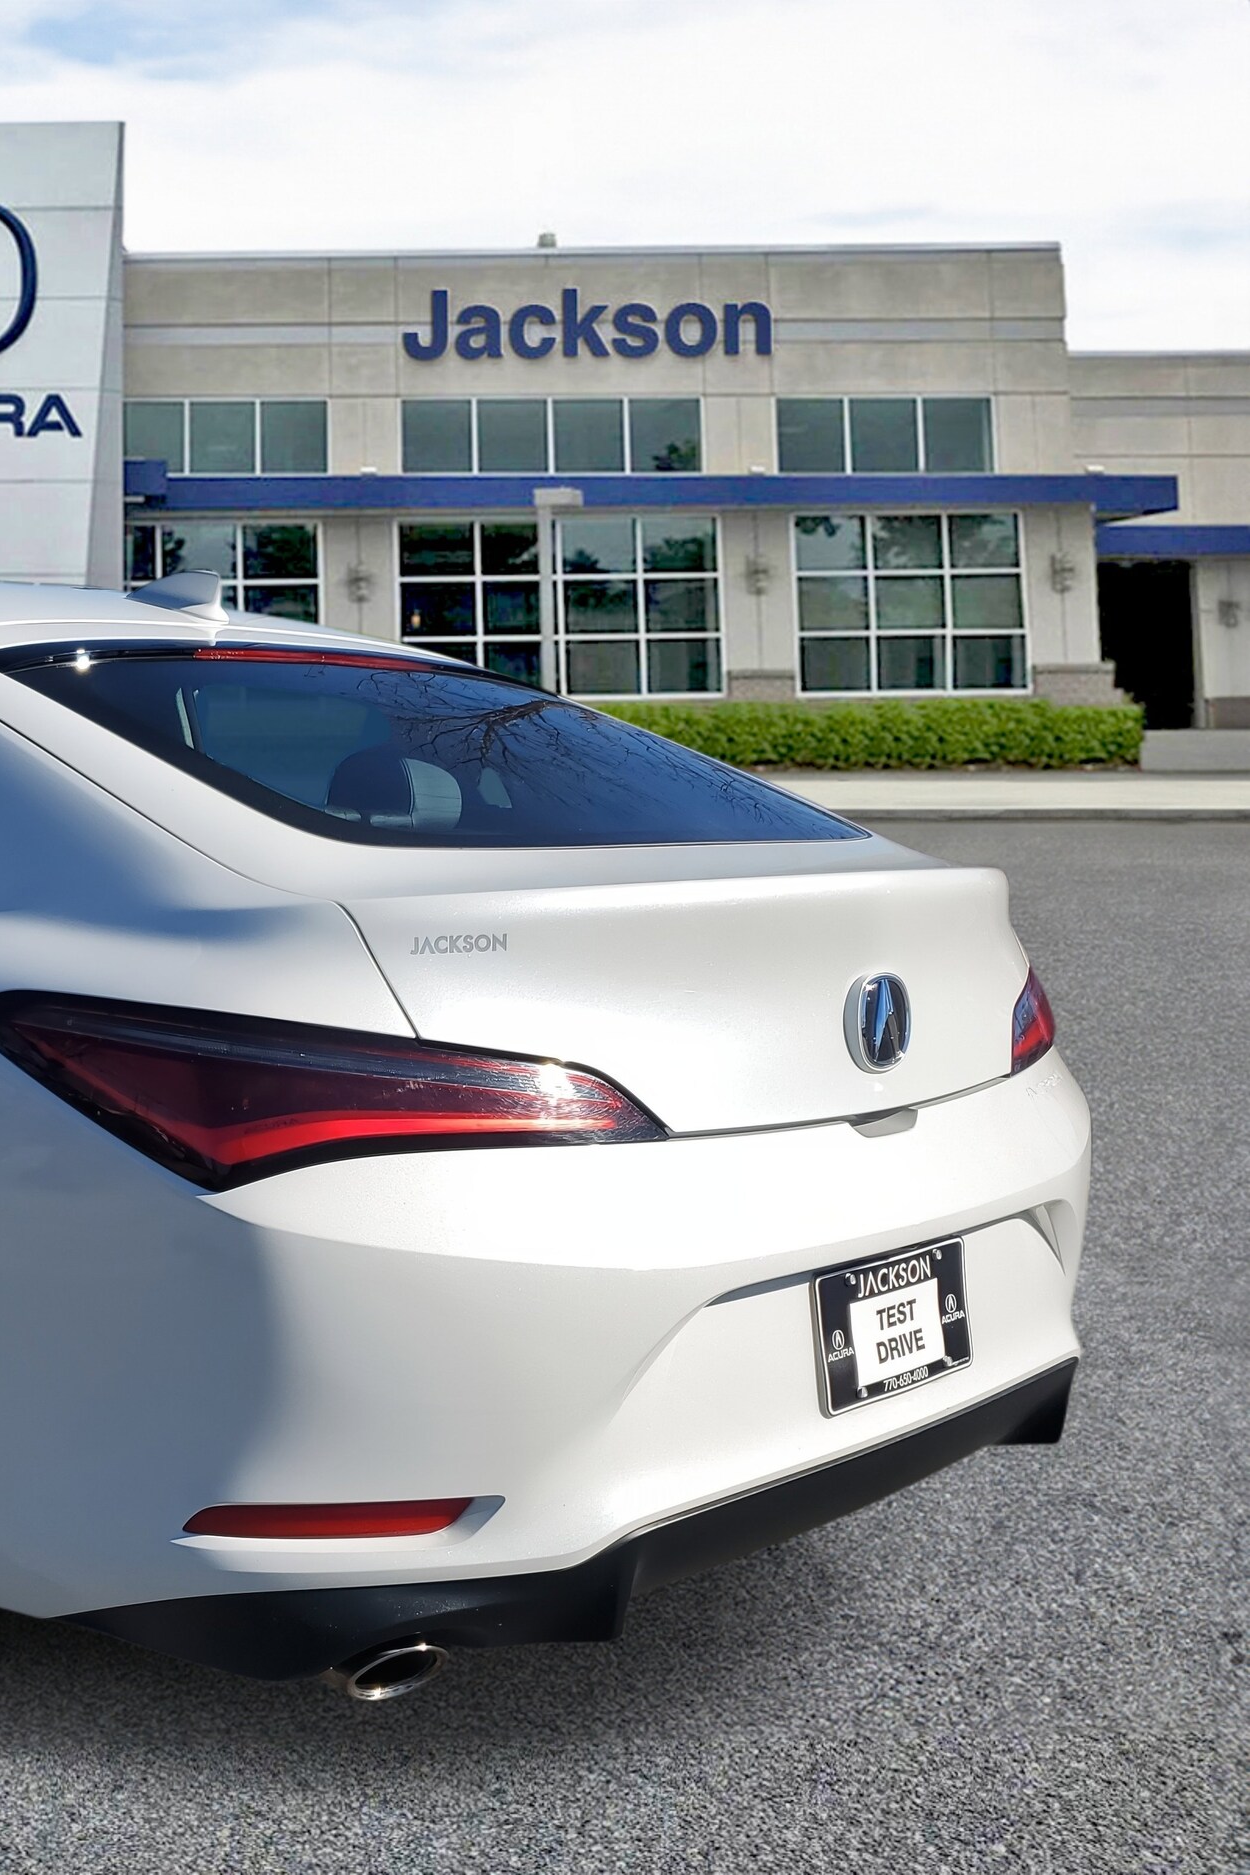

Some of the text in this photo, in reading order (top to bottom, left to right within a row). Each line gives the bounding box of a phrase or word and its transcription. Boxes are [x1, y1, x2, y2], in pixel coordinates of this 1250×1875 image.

[402, 288, 772, 360] Jackson
[410, 933, 508, 955] JACKSON
[857, 1254, 932, 1298] JACKSON
[876, 1299, 917, 1331] TEST
[941, 1309, 965, 1325] ACURA
[827, 1346, 855, 1363] ACURA
[876, 1328, 926, 1364] DRIVE
[883, 1366, 929, 1392] 770-650-4000
